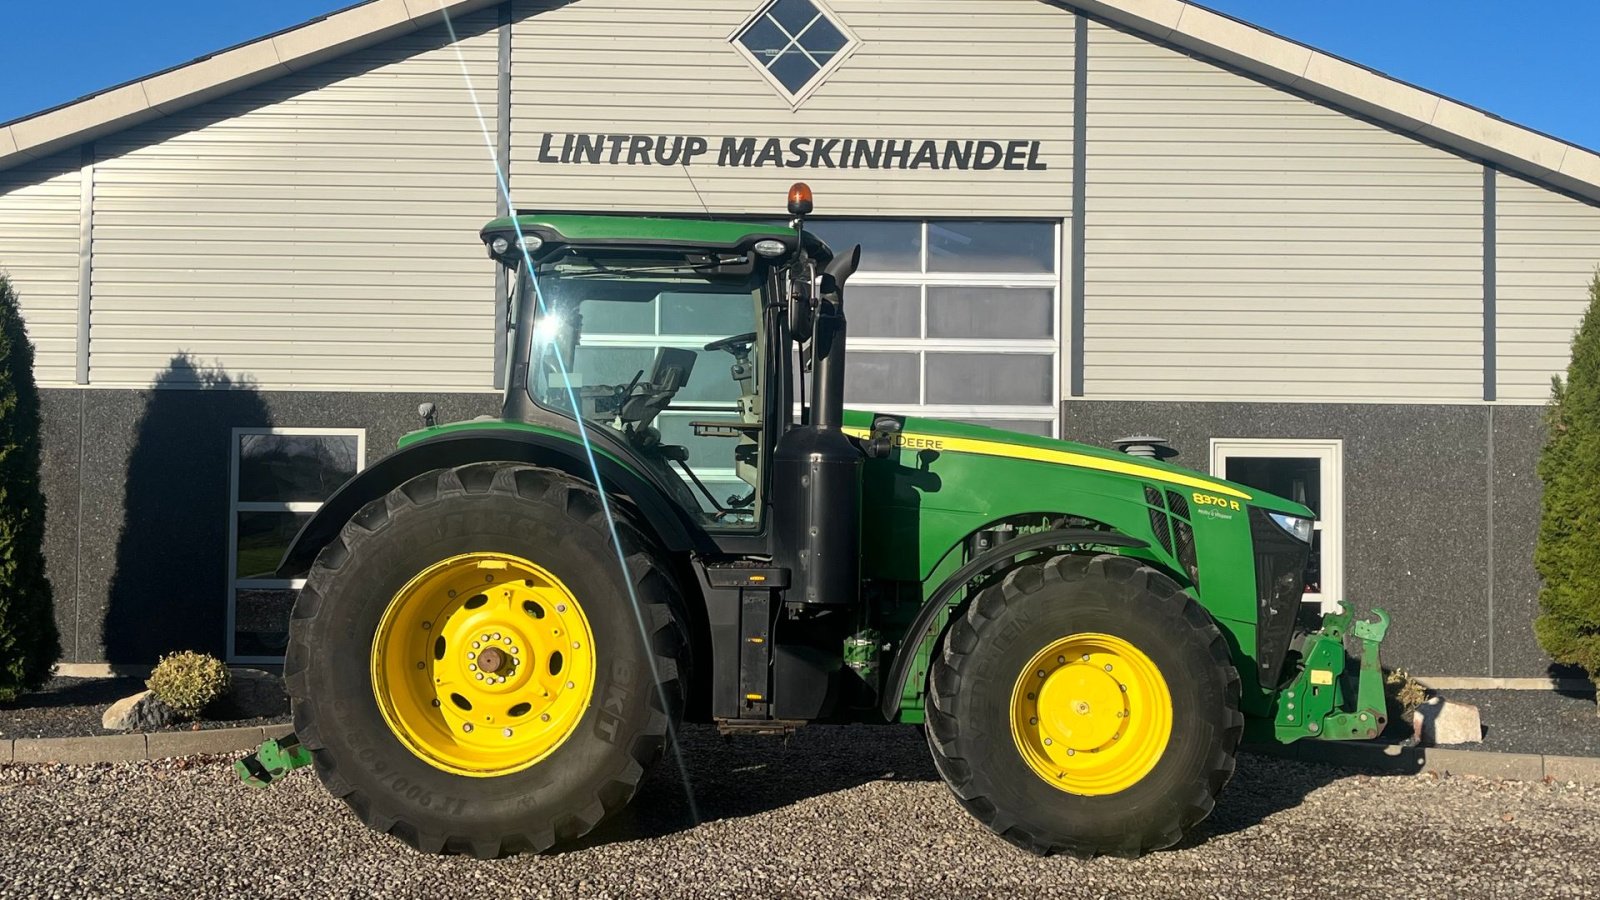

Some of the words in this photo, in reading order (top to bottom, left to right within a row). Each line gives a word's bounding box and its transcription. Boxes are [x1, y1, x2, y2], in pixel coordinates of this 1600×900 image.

[538, 132, 708, 166] LINTRUP
[717, 137, 1048, 171] MASKINHANDEL
[896, 435, 944, 449] DEERE
[1192, 493, 1228, 508] 8370
[1229, 499, 1240, 511] R
[598, 657, 632, 742] BKT
